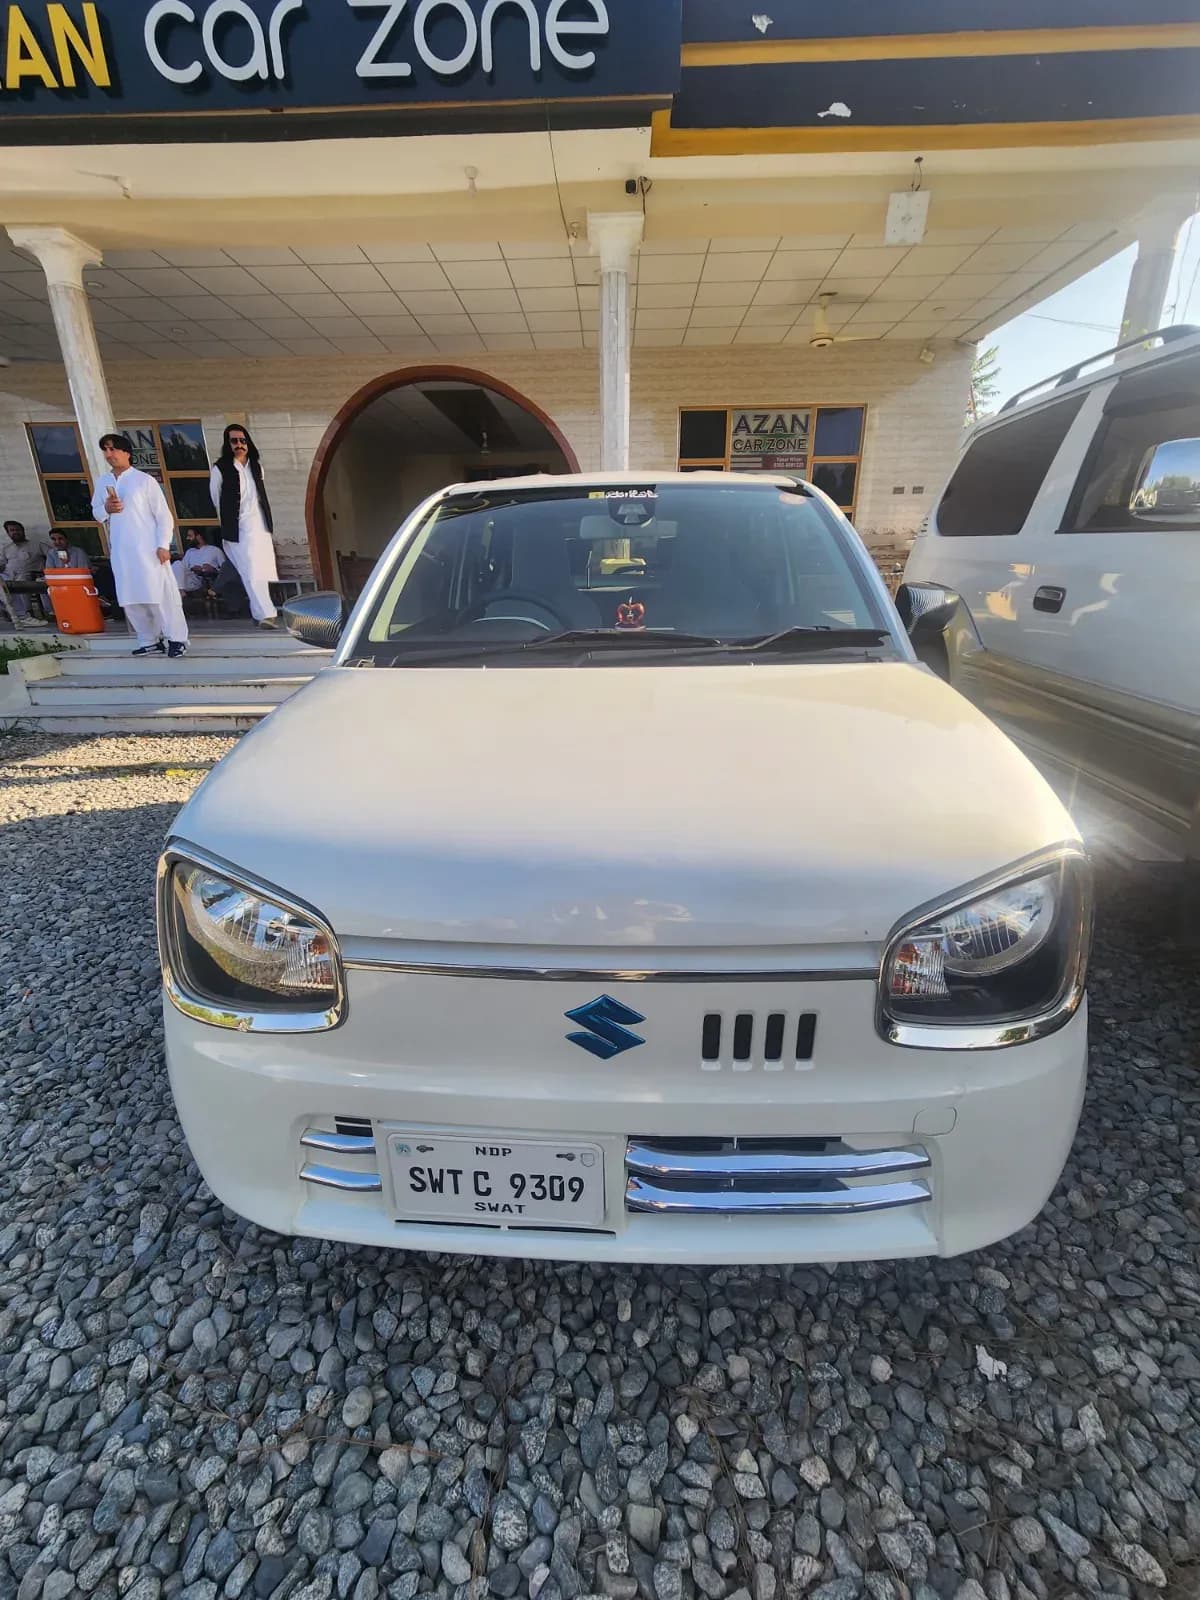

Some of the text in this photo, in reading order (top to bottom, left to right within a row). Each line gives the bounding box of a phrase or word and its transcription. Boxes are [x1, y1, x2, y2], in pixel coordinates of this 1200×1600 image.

[0, 0, 609, 88] AN car zone
[733, 413, 810, 434] AZAN
[733, 438, 807, 450] CAR ZONE
[475, 1146, 513, 1157] NDP
[409, 1166, 585, 1202] SWT C 9309
[474, 1203, 527, 1214] SWAT
